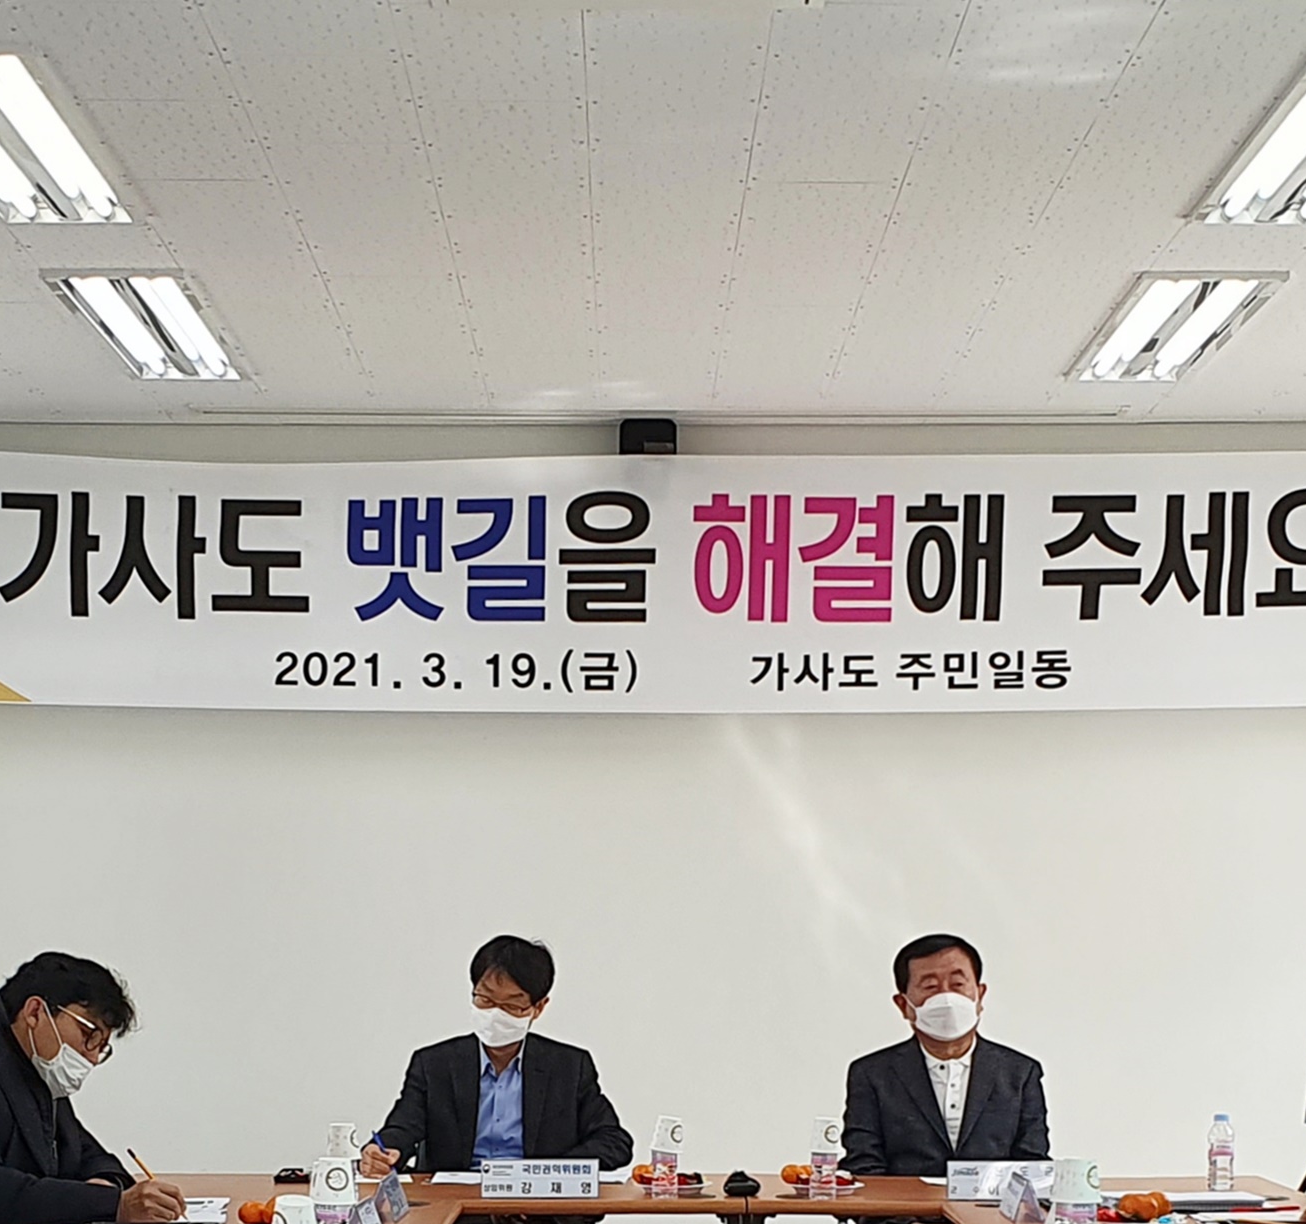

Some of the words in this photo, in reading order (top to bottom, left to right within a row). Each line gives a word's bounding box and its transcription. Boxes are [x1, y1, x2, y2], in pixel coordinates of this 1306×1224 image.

[347, 490, 657, 623] 뱃길을
[692, 492, 1006, 623] 해결해
[274, 651, 404, 689] 2021.
[421, 652, 463, 689] 3.
[485, 650, 640, 693] 19.(금)
[749, 652, 878, 692] 가사도
[895, 650, 1072, 692] 주민일동
